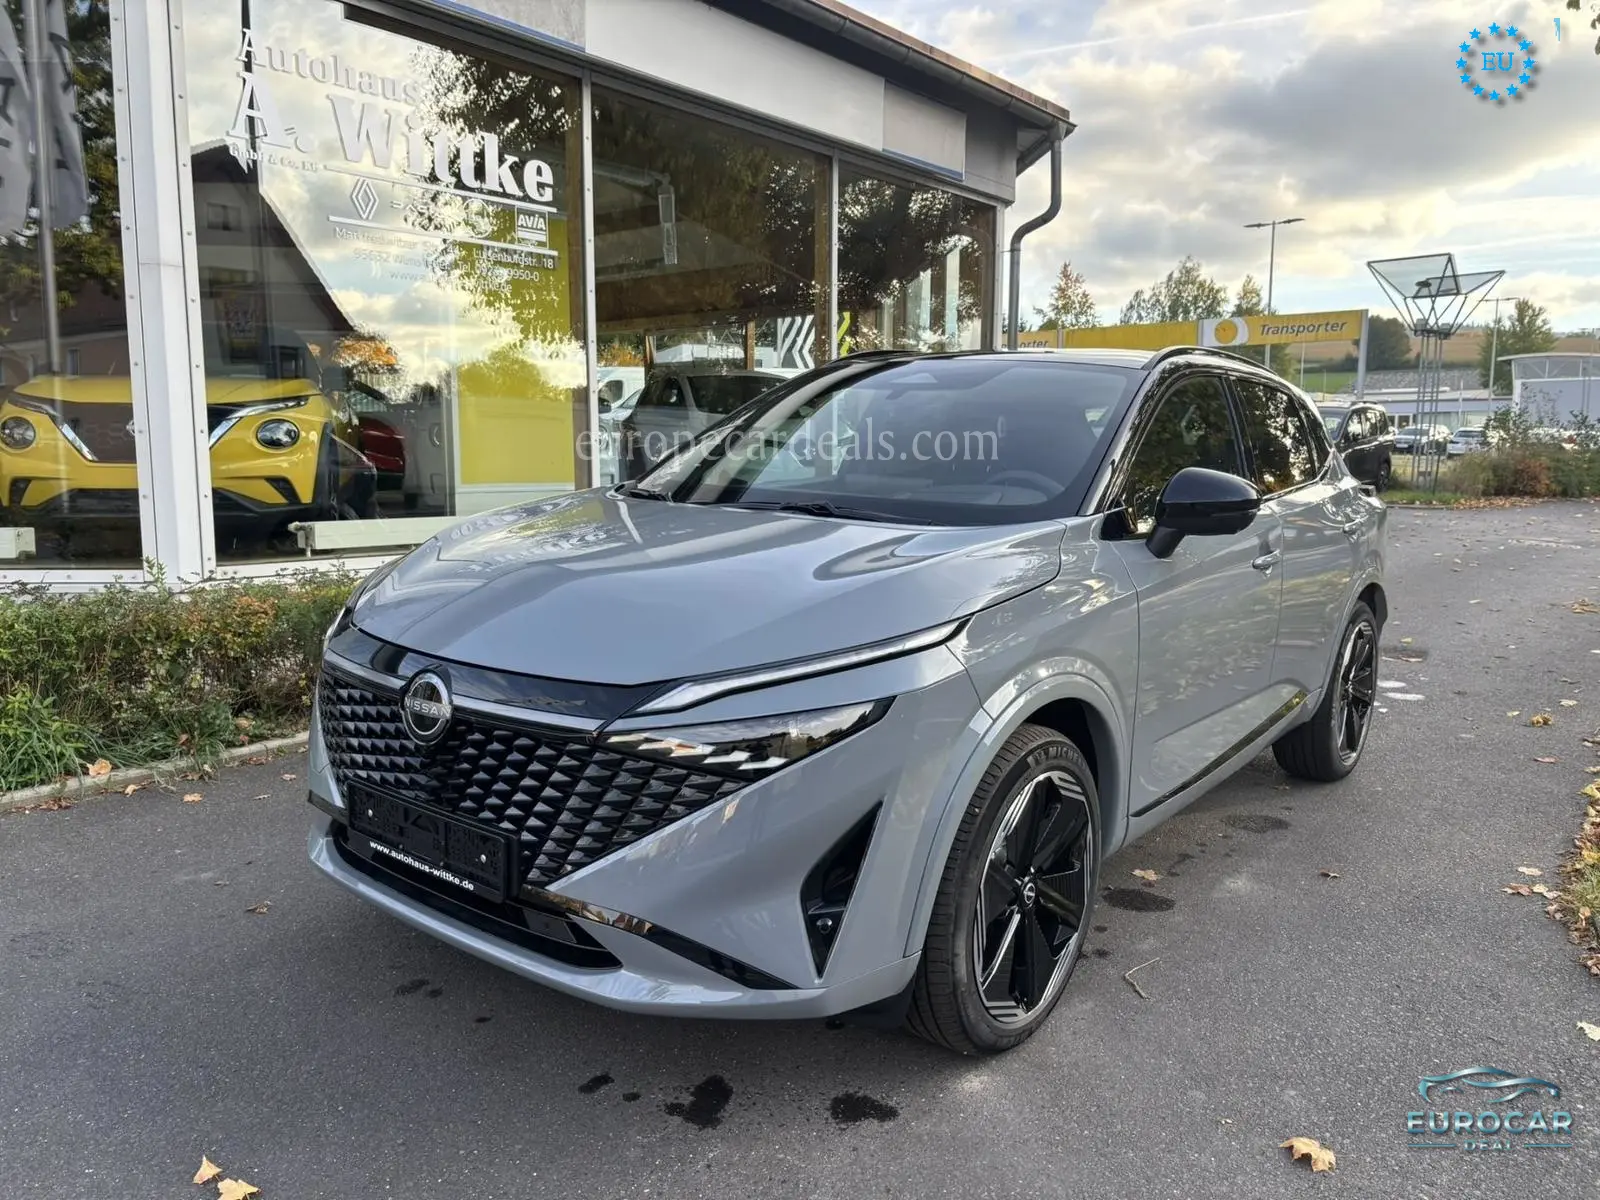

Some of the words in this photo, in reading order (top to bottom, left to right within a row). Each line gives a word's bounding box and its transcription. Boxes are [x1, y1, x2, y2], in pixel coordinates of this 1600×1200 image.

[236, 28, 418, 107] Autohaus
[325, 92, 554, 202] Wittke
[543, 258, 555, 270] 18
[1260, 321, 1348, 336] Transporter
[404, 697, 451, 720] NISSAN
[369, 840, 475, 892] www.autohaus-wittke.de
